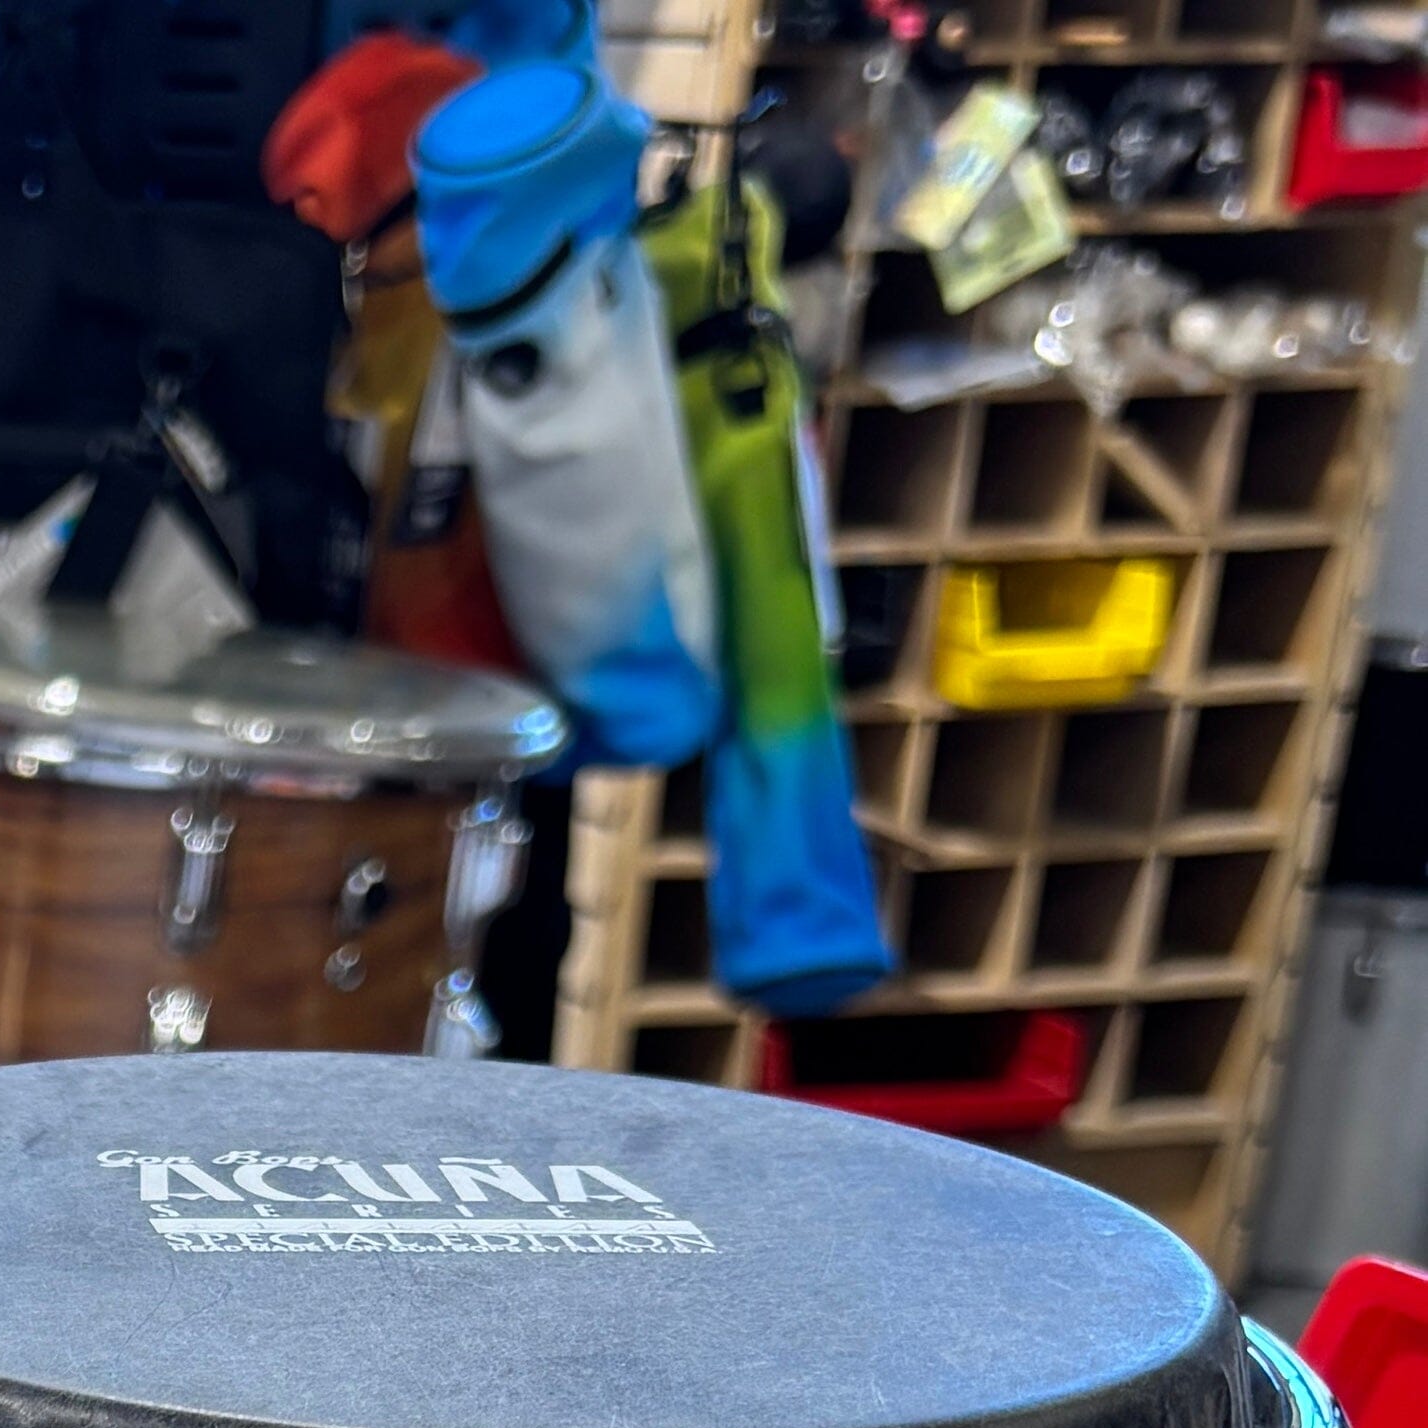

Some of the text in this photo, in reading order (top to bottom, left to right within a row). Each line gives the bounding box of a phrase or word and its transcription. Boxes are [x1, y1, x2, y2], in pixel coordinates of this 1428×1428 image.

[96, 1150, 346, 1170] Gon Bops
[140, 1157, 664, 1202] ACUÑA
[164, 1232, 716, 1250] SPECIAL EDITION
